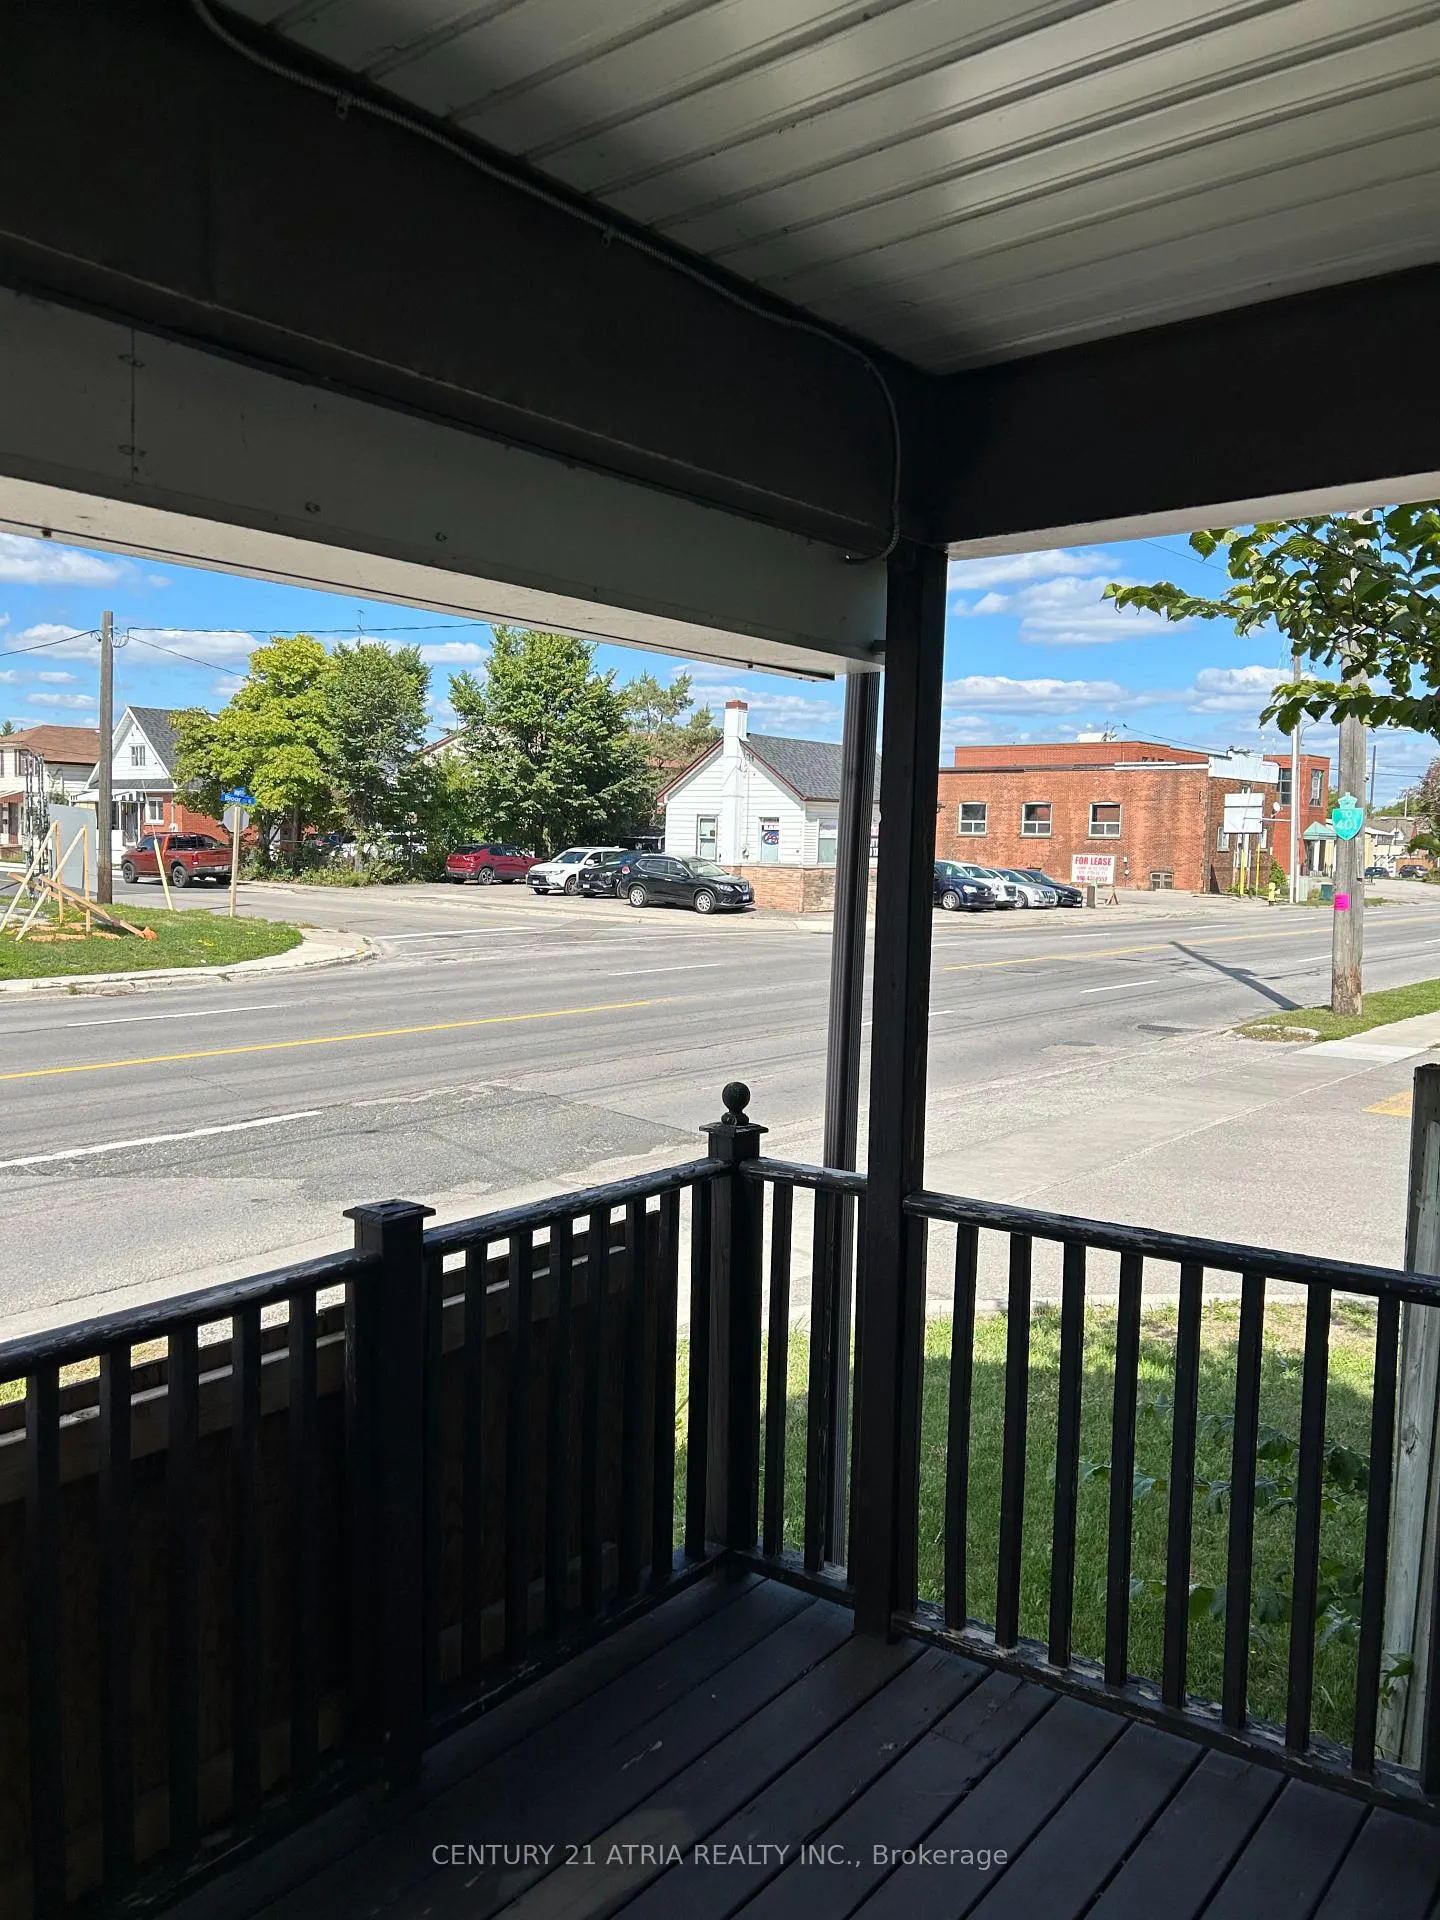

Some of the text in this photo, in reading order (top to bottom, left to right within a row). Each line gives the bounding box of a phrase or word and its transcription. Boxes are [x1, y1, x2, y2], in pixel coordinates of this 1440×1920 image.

[1335, 817, 1357, 830] 401
[1075, 856, 1111, 866] FOR LEASE
